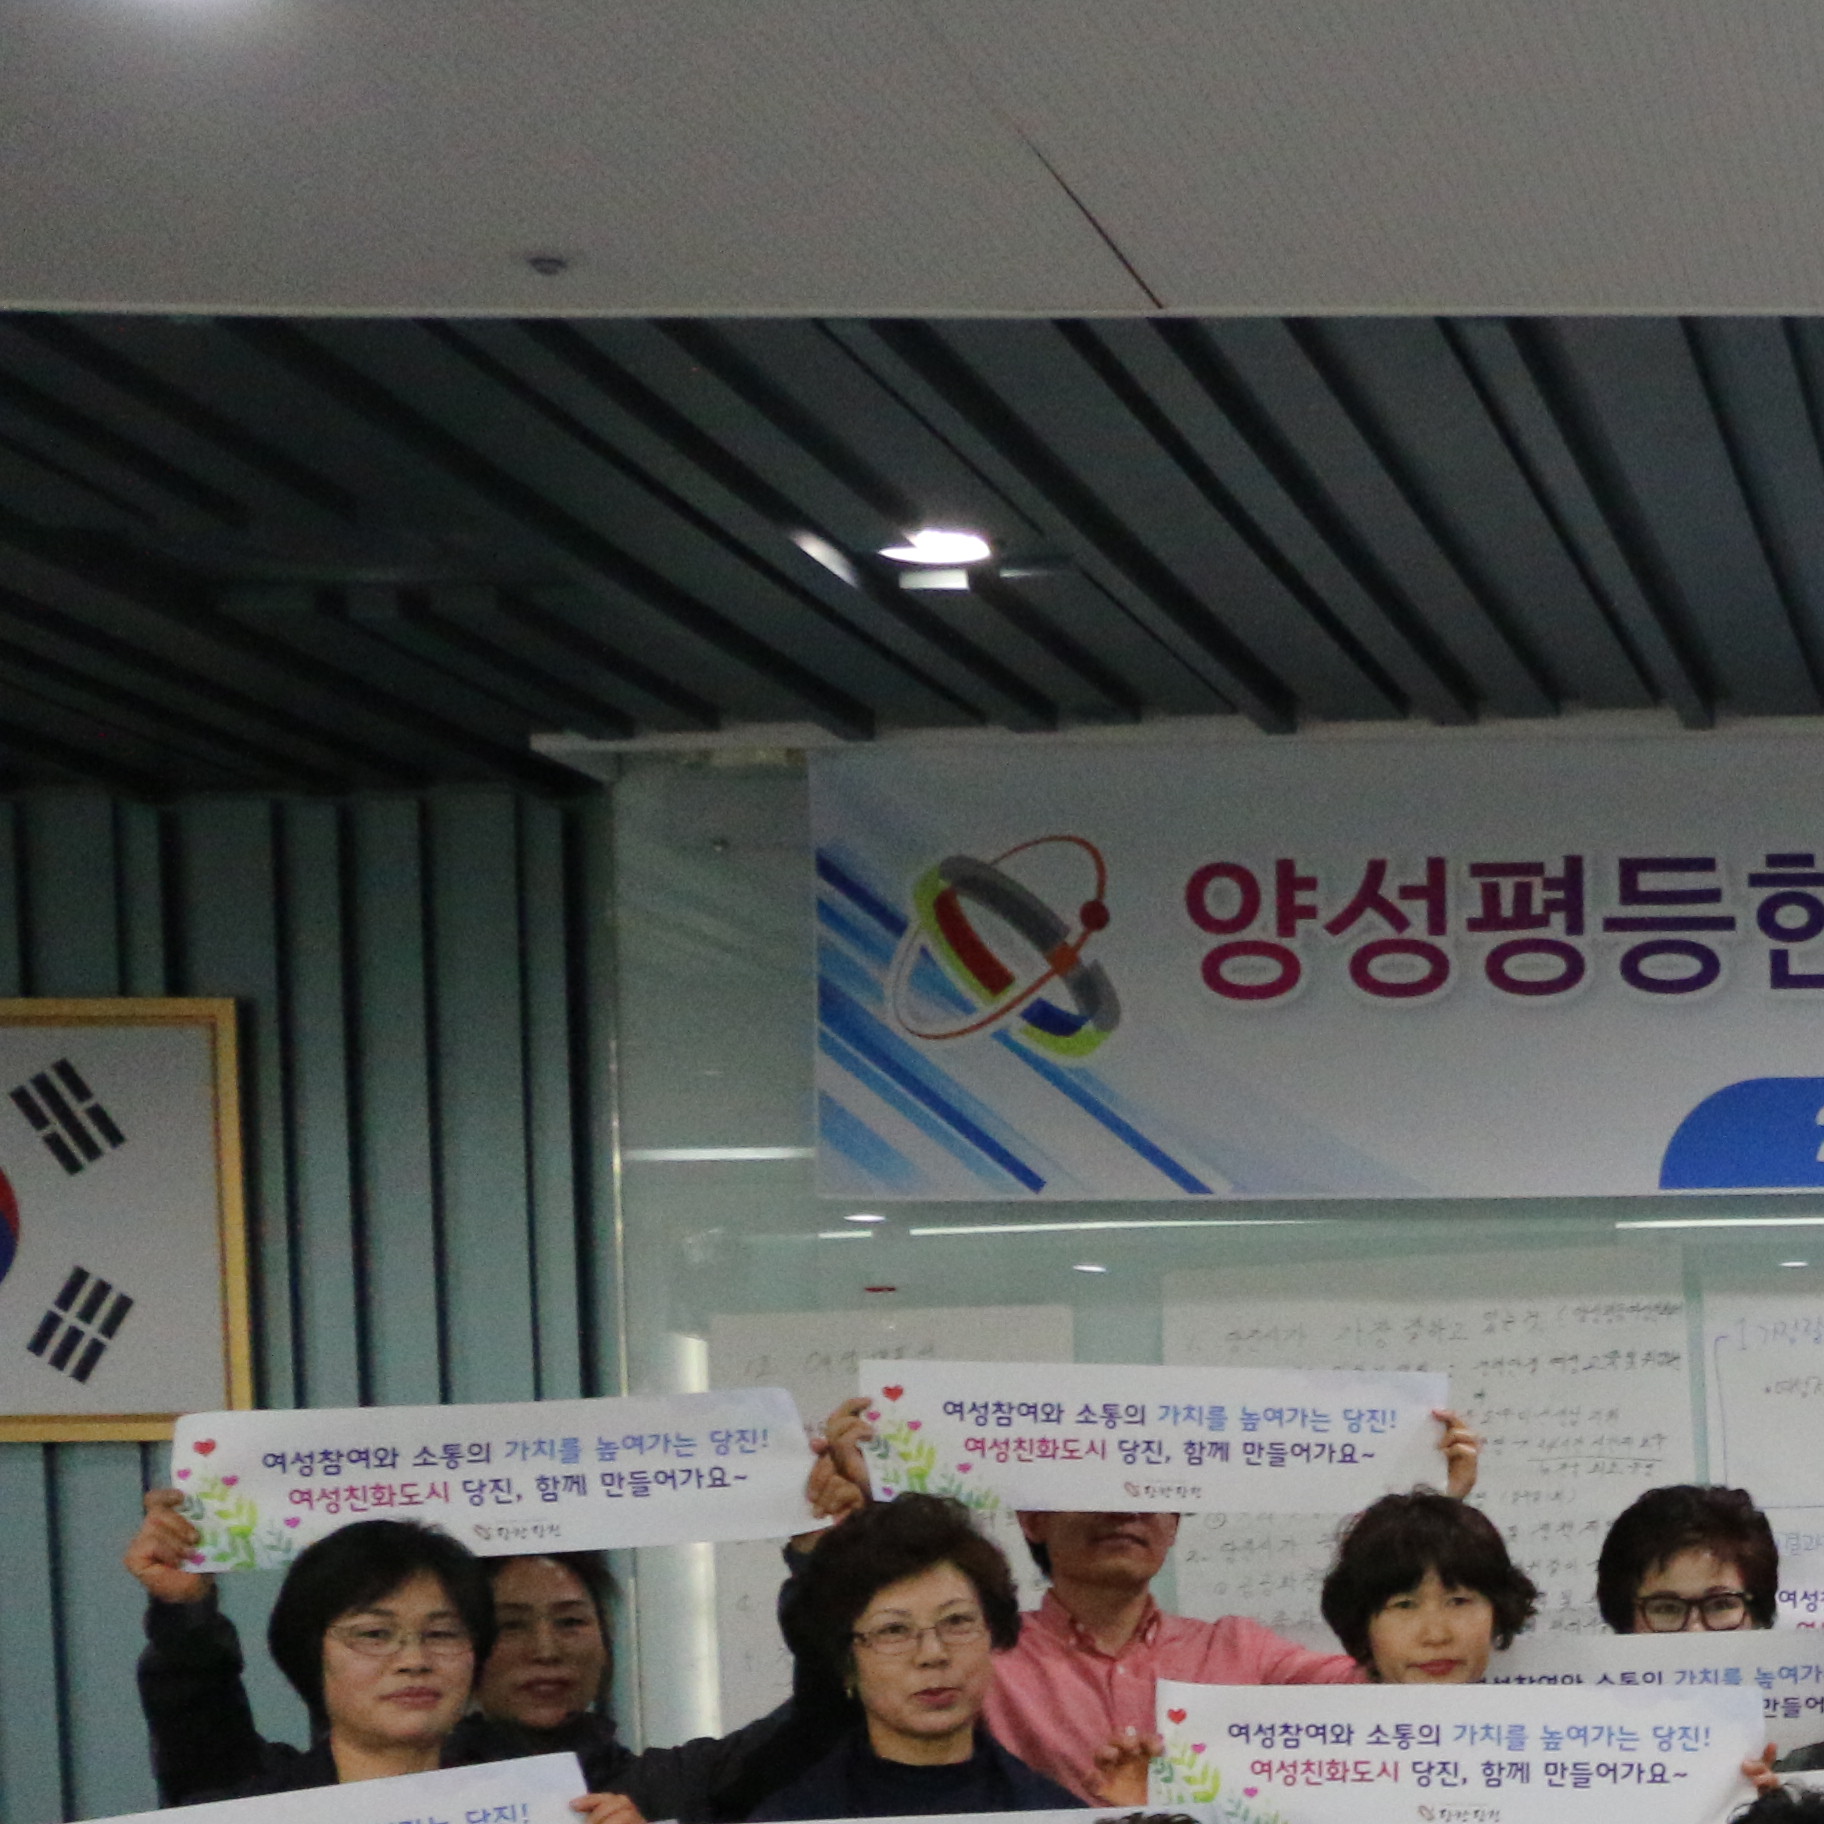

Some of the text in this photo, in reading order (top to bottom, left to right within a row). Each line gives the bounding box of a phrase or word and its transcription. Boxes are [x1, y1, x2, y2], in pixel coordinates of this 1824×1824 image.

[941, 1399, 1397, 1435] 여성참여와 소통의 가치를 높여가는 당진!
[260, 1427, 769, 1479] 여성참여와 소통의 가치를 높여가는 당진!
[963, 1435, 1376, 1469] 여성친화도시 당진, 함께 만들어가요~
[287, 1464, 749, 1516] 여성친화도시 당진, 함께 만들어가요~
[1226, 1721, 1711, 1753] 여성참여와 소통의 가치를 높여가는 당진!
[1249, 1758, 1689, 1790] 여성친화도시 당진, 함께 만들어가요~
